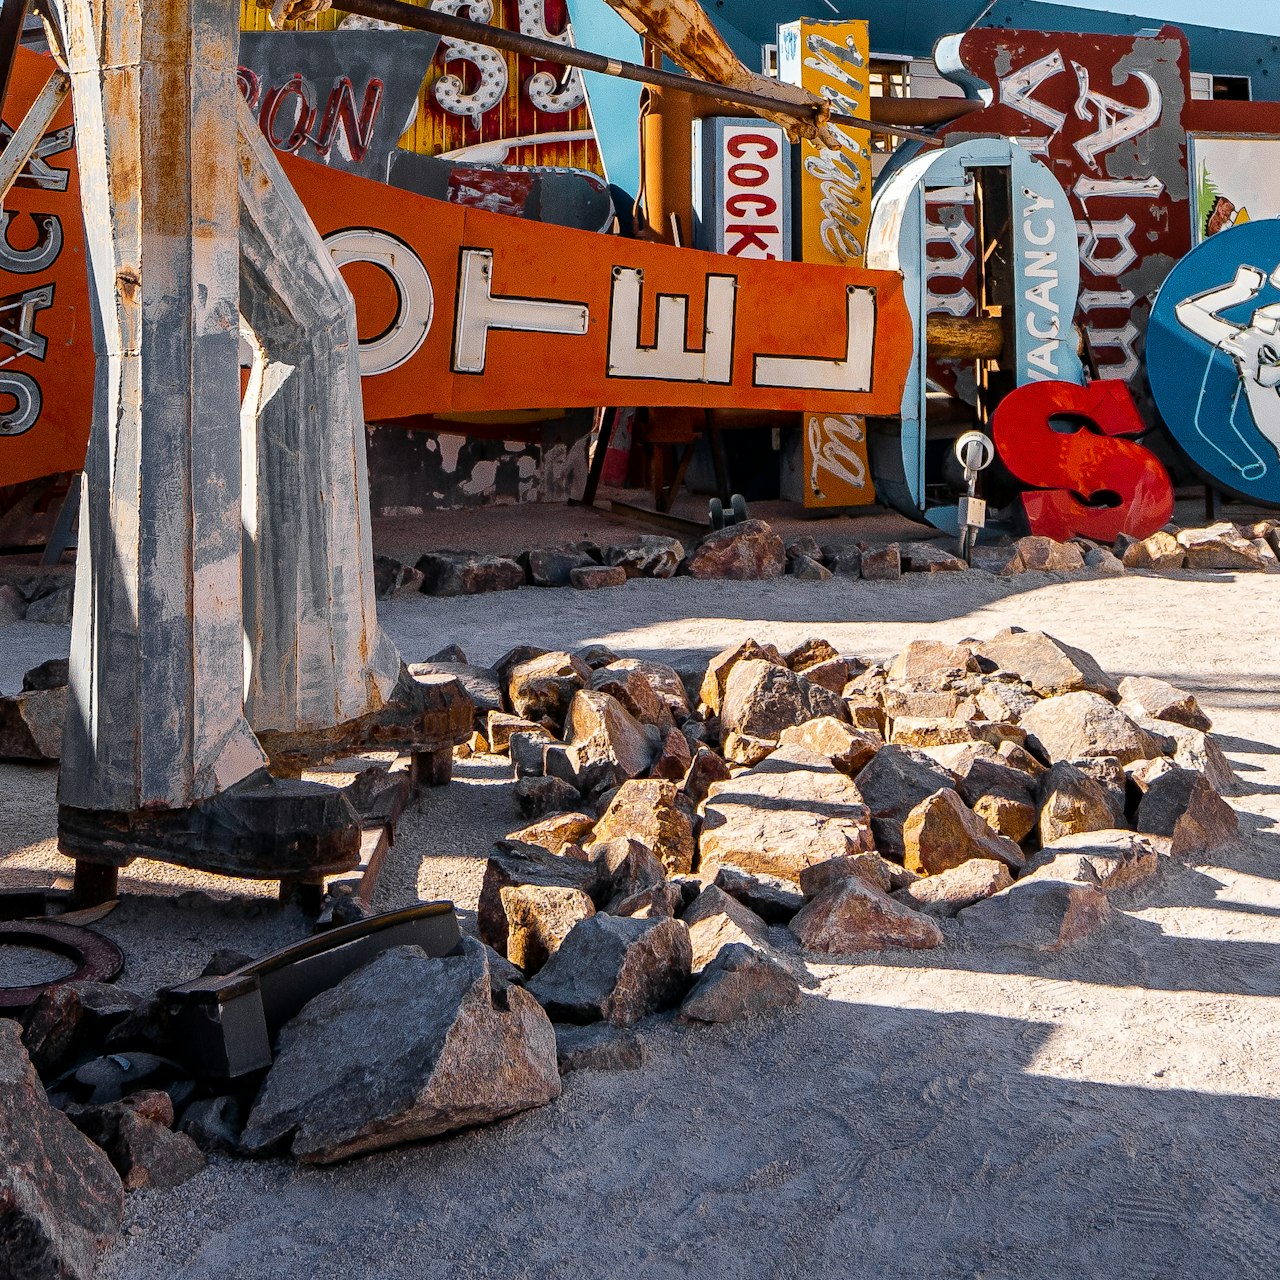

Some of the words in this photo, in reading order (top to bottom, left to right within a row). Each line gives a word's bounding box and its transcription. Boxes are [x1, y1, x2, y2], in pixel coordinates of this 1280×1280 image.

[237, 65, 385, 164] ON
[725, 133, 780, 261] COCK
[1070, 59, 1166, 381] Alpin
[324, 226, 878, 394] OTEL
[992, 378, 1176, 543] S
